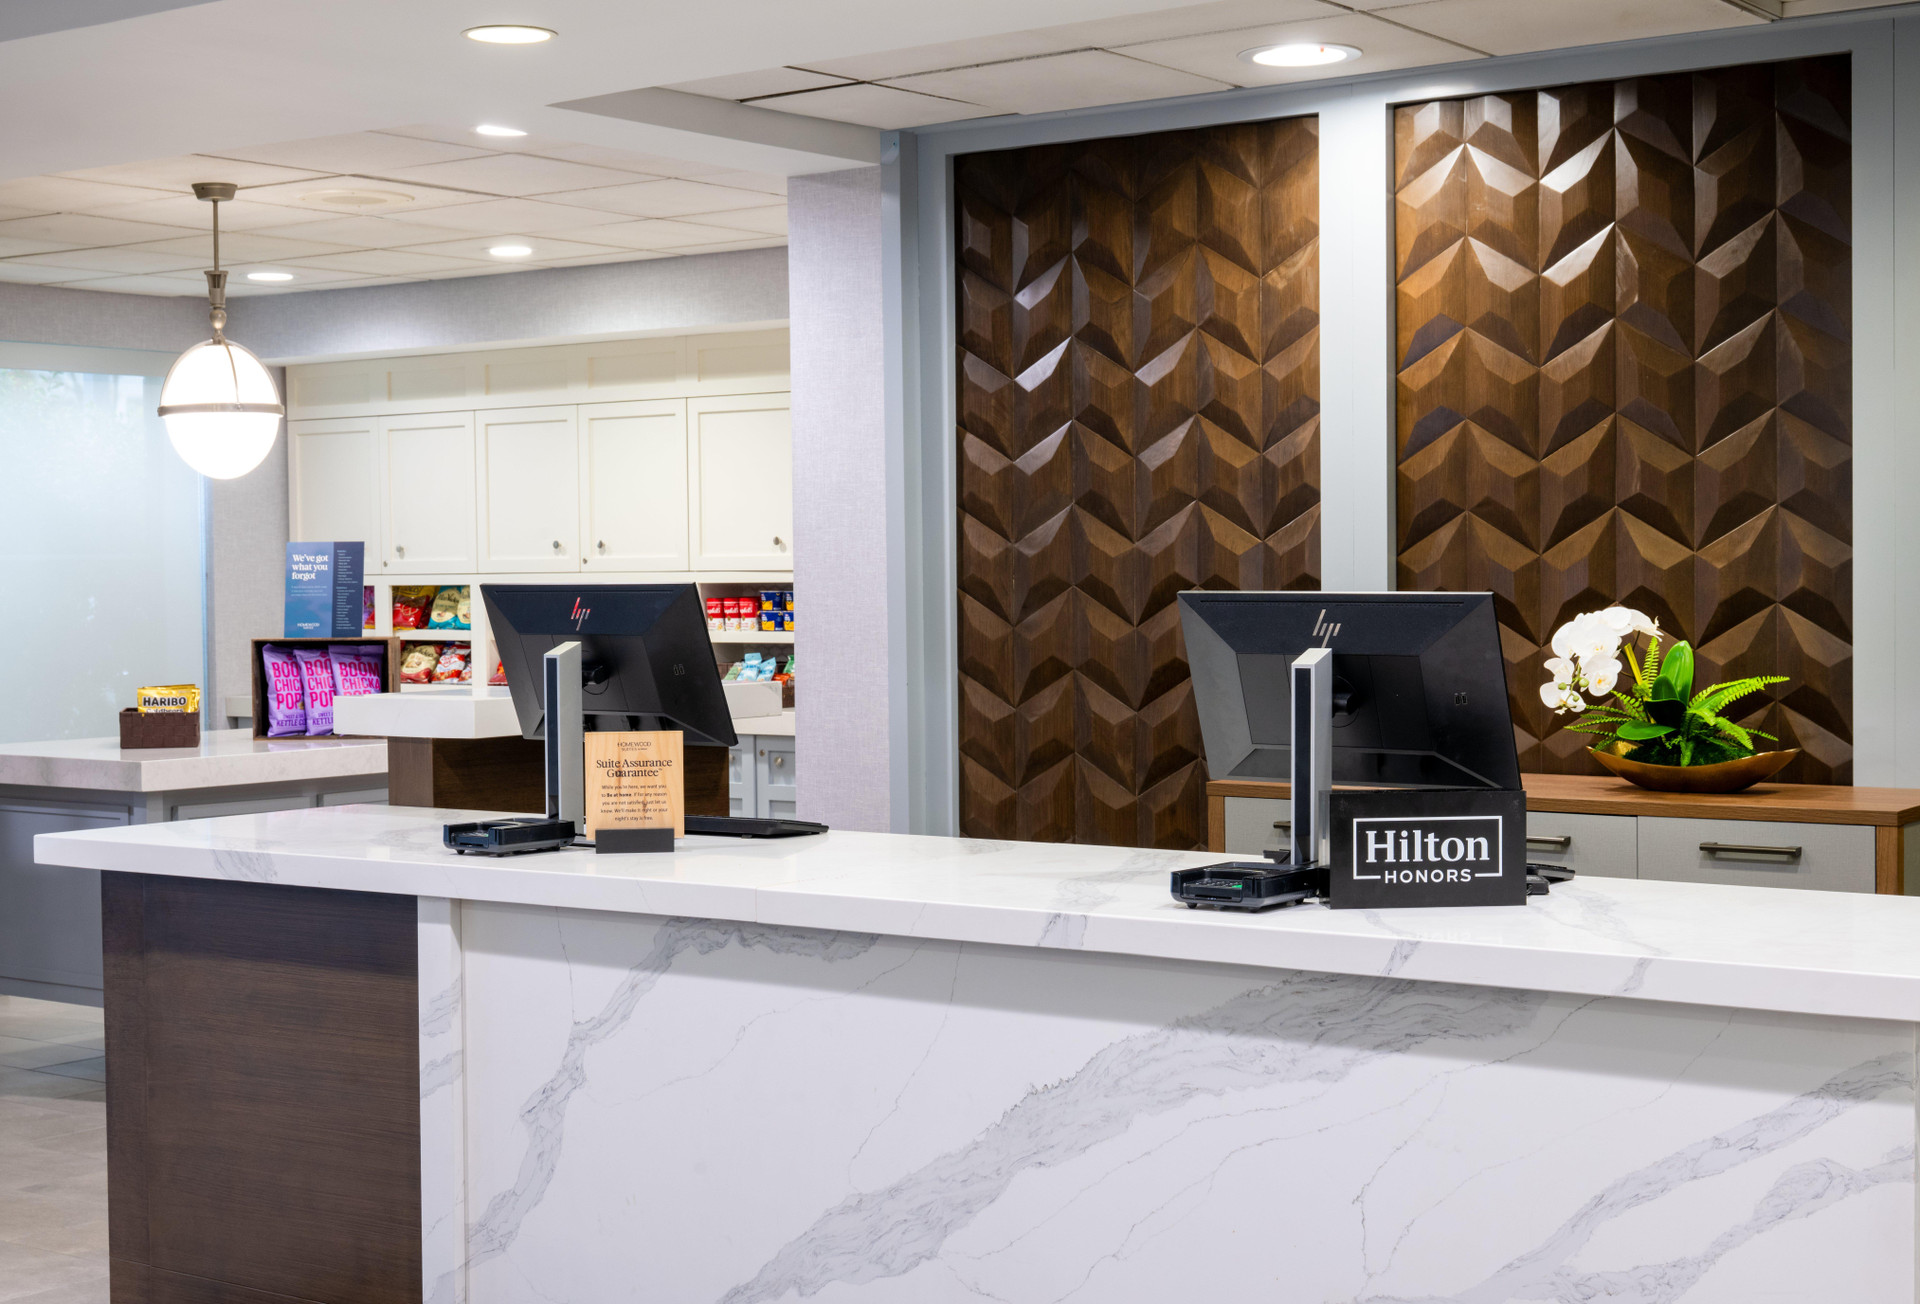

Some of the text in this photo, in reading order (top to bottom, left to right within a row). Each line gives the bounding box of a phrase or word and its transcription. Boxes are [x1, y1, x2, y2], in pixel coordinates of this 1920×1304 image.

[292, 554, 329, 564] We've got
[292, 563, 328, 572] what you
[291, 571, 316, 581] forgot
[570, 596, 591, 631] hp
[1312, 608, 1342, 648] hp
[271, 661, 300, 678] BOO
[303, 658, 333, 676] BOO
[338, 661, 381, 678] BOOM
[274, 678, 303, 692] CHIC
[307, 676, 335, 690] CHIC
[341, 677, 382, 691] CHICKA
[143, 696, 187, 707] HARIBO
[276, 692, 302, 710] POP
[276, 719, 298, 727] KETTLE
[596, 759, 672, 769] Suite Assurance
[1365, 829, 1491, 864] Hilton
[1384, 868, 1473, 884] HONORS
